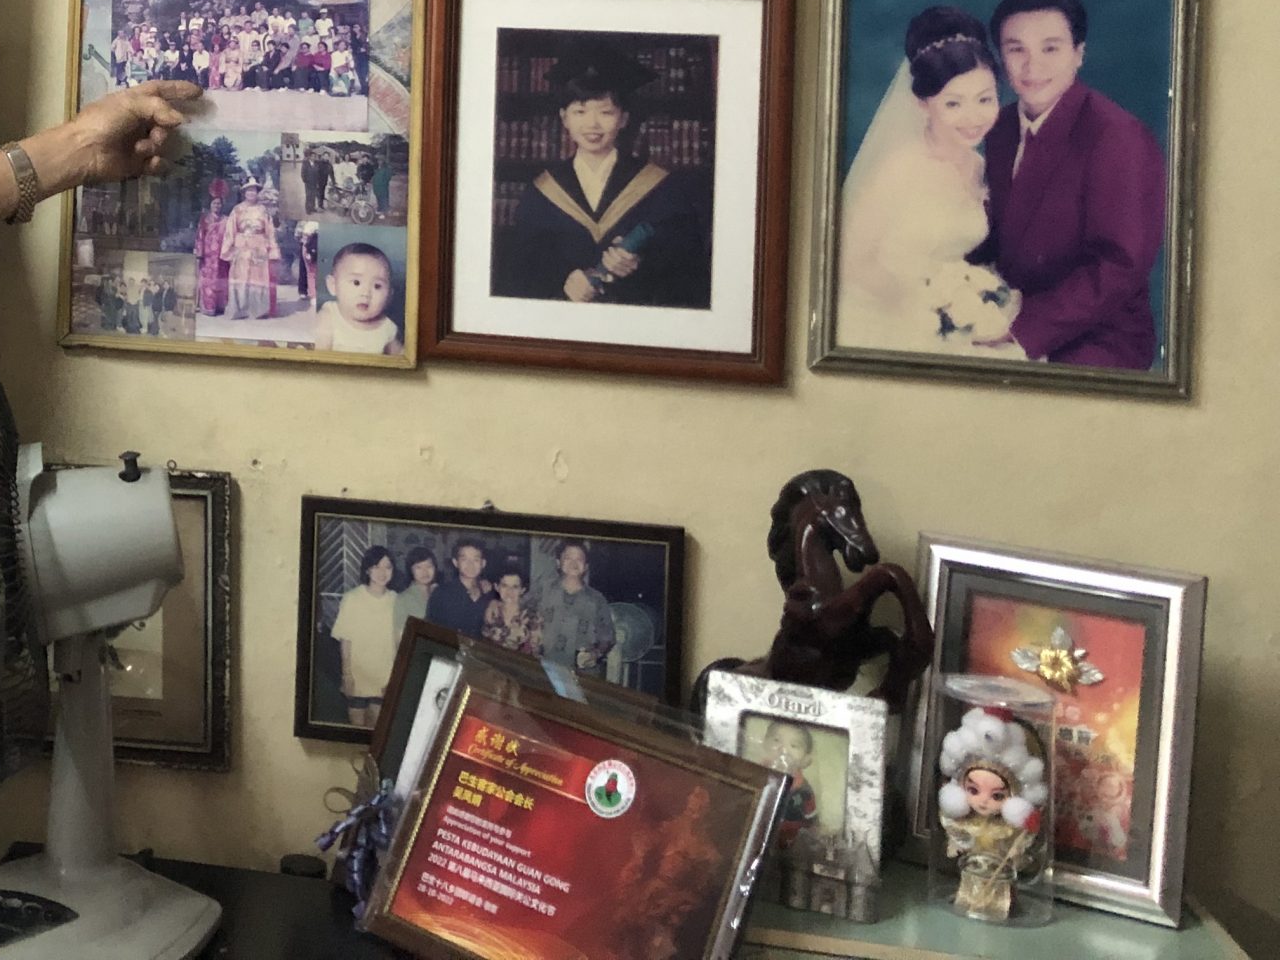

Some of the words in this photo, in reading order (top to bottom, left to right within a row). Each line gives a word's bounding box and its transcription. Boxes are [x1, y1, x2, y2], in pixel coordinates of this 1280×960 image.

[427, 852, 448, 868] 2022
[431, 840, 498, 876] ANTARABANGSA
[498, 868, 542, 895] MALAYSIA
[436, 828, 461, 844] PESTA
[461, 839, 516, 869] KEBUDAYAAN
[516, 862, 543, 880] GUAN
[543, 873, 572, 894] GONG
